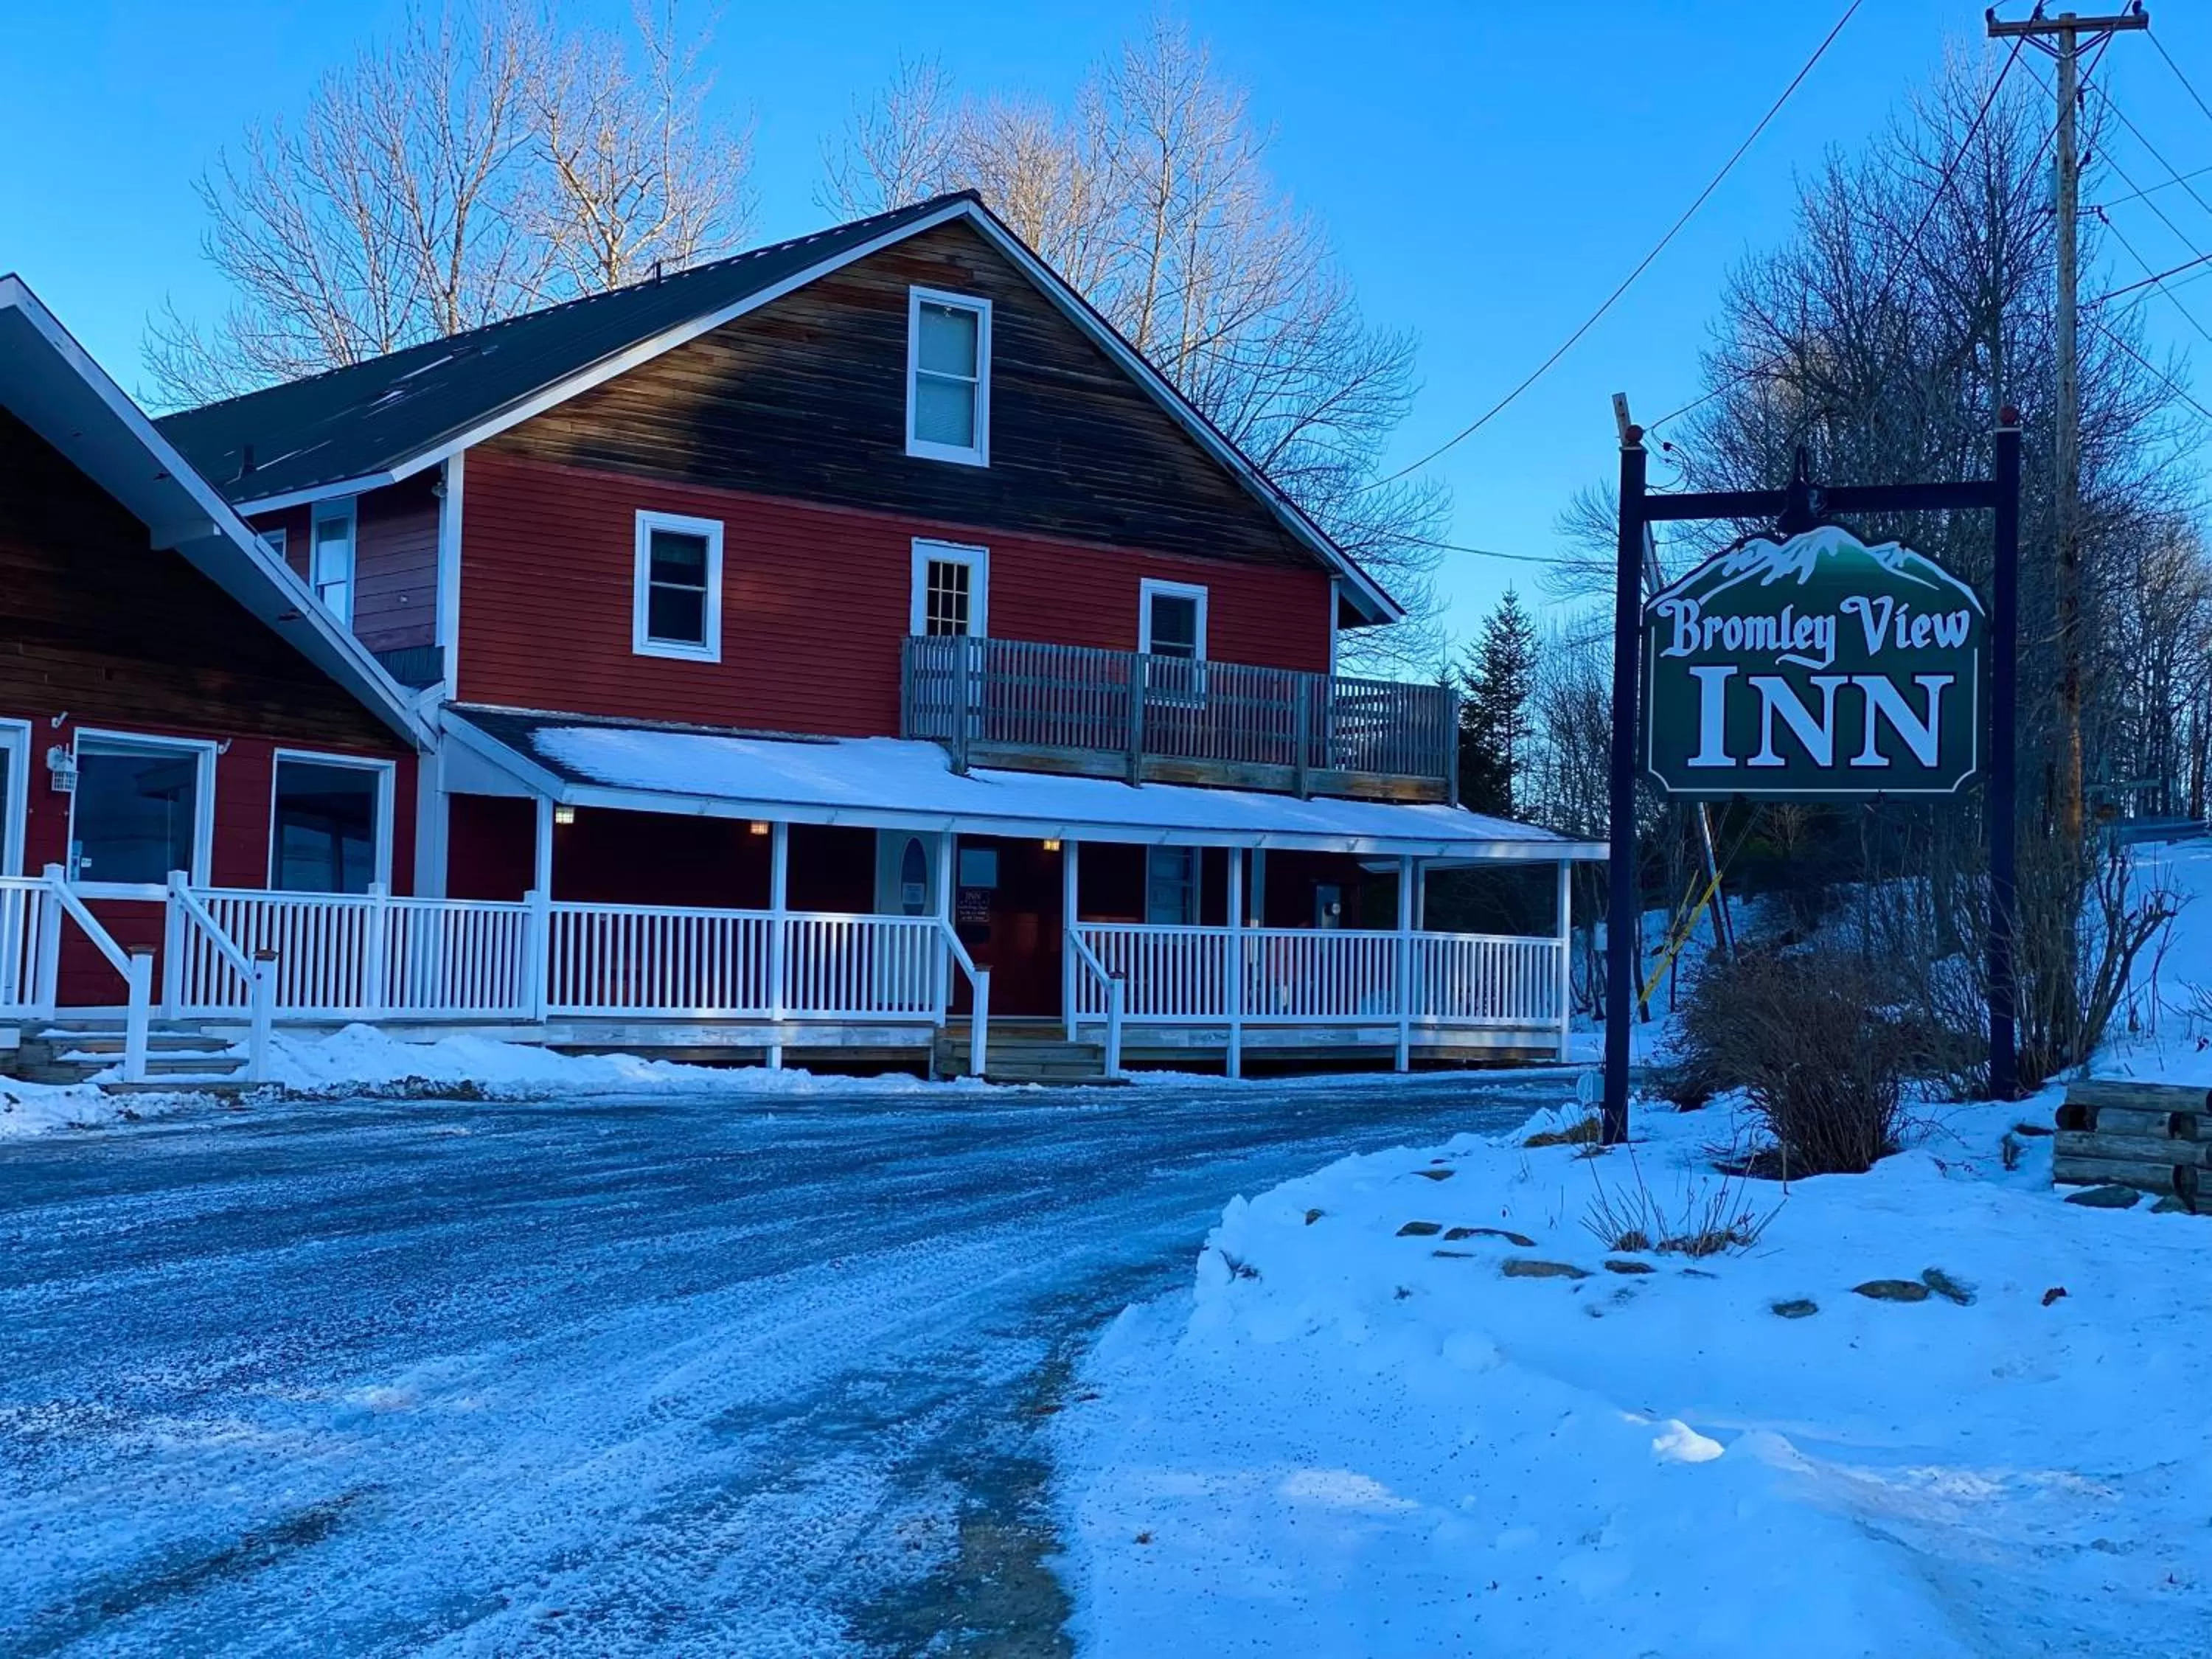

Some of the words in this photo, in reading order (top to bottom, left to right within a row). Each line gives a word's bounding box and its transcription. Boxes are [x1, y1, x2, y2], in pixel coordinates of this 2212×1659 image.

[1657, 599, 1836, 669] Bromley
[1840, 595, 1969, 655] View
[1688, 666, 1954, 768] INN
